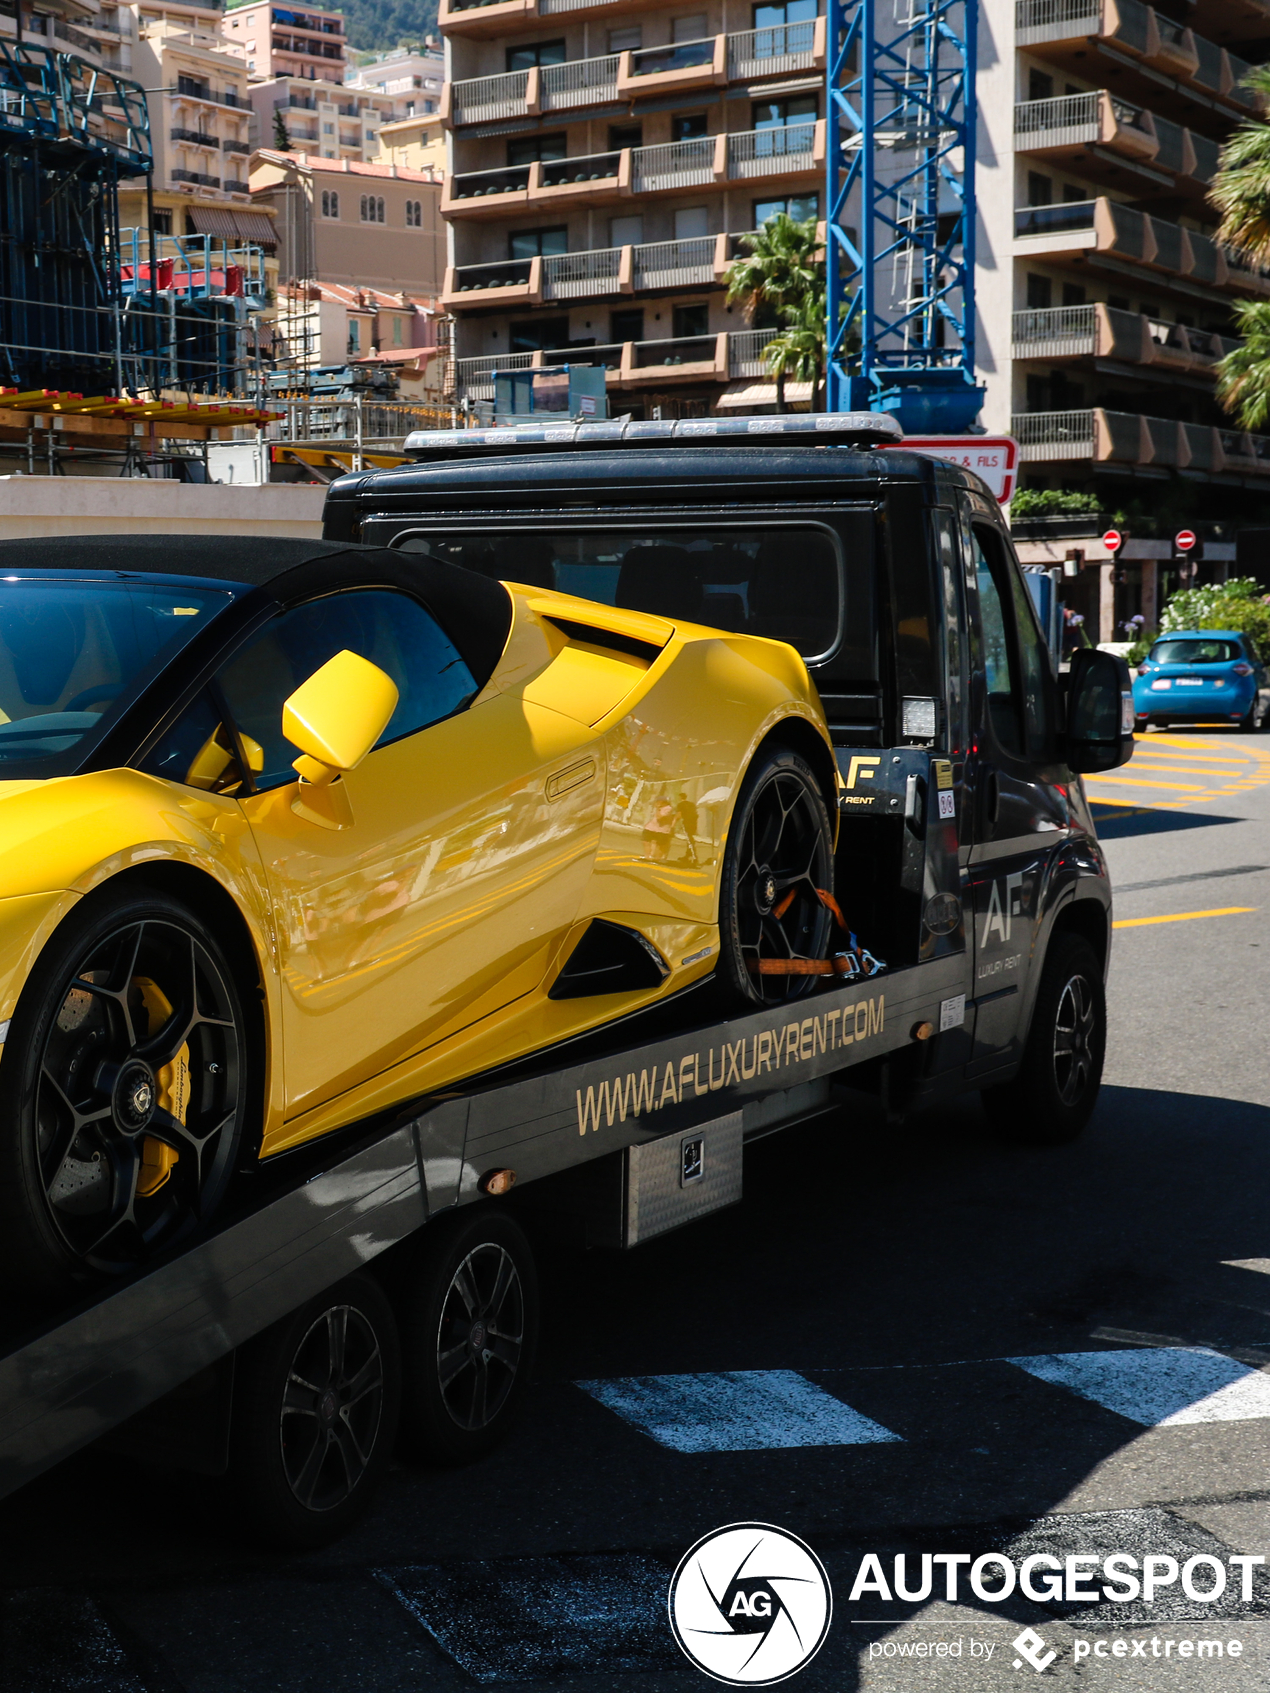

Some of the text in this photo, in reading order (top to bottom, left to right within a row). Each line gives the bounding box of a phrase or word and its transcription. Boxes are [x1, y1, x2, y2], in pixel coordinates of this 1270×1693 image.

[961, 456, 971, 467] &
[977, 456, 998, 467] FILS
[845, 796, 875, 805] RENT
[980, 871, 1023, 949] AF
[978, 953, 1022, 979] LUXURY RENT
[576, 995, 885, 1136] WWW.AFLUXURYRENT.COM
